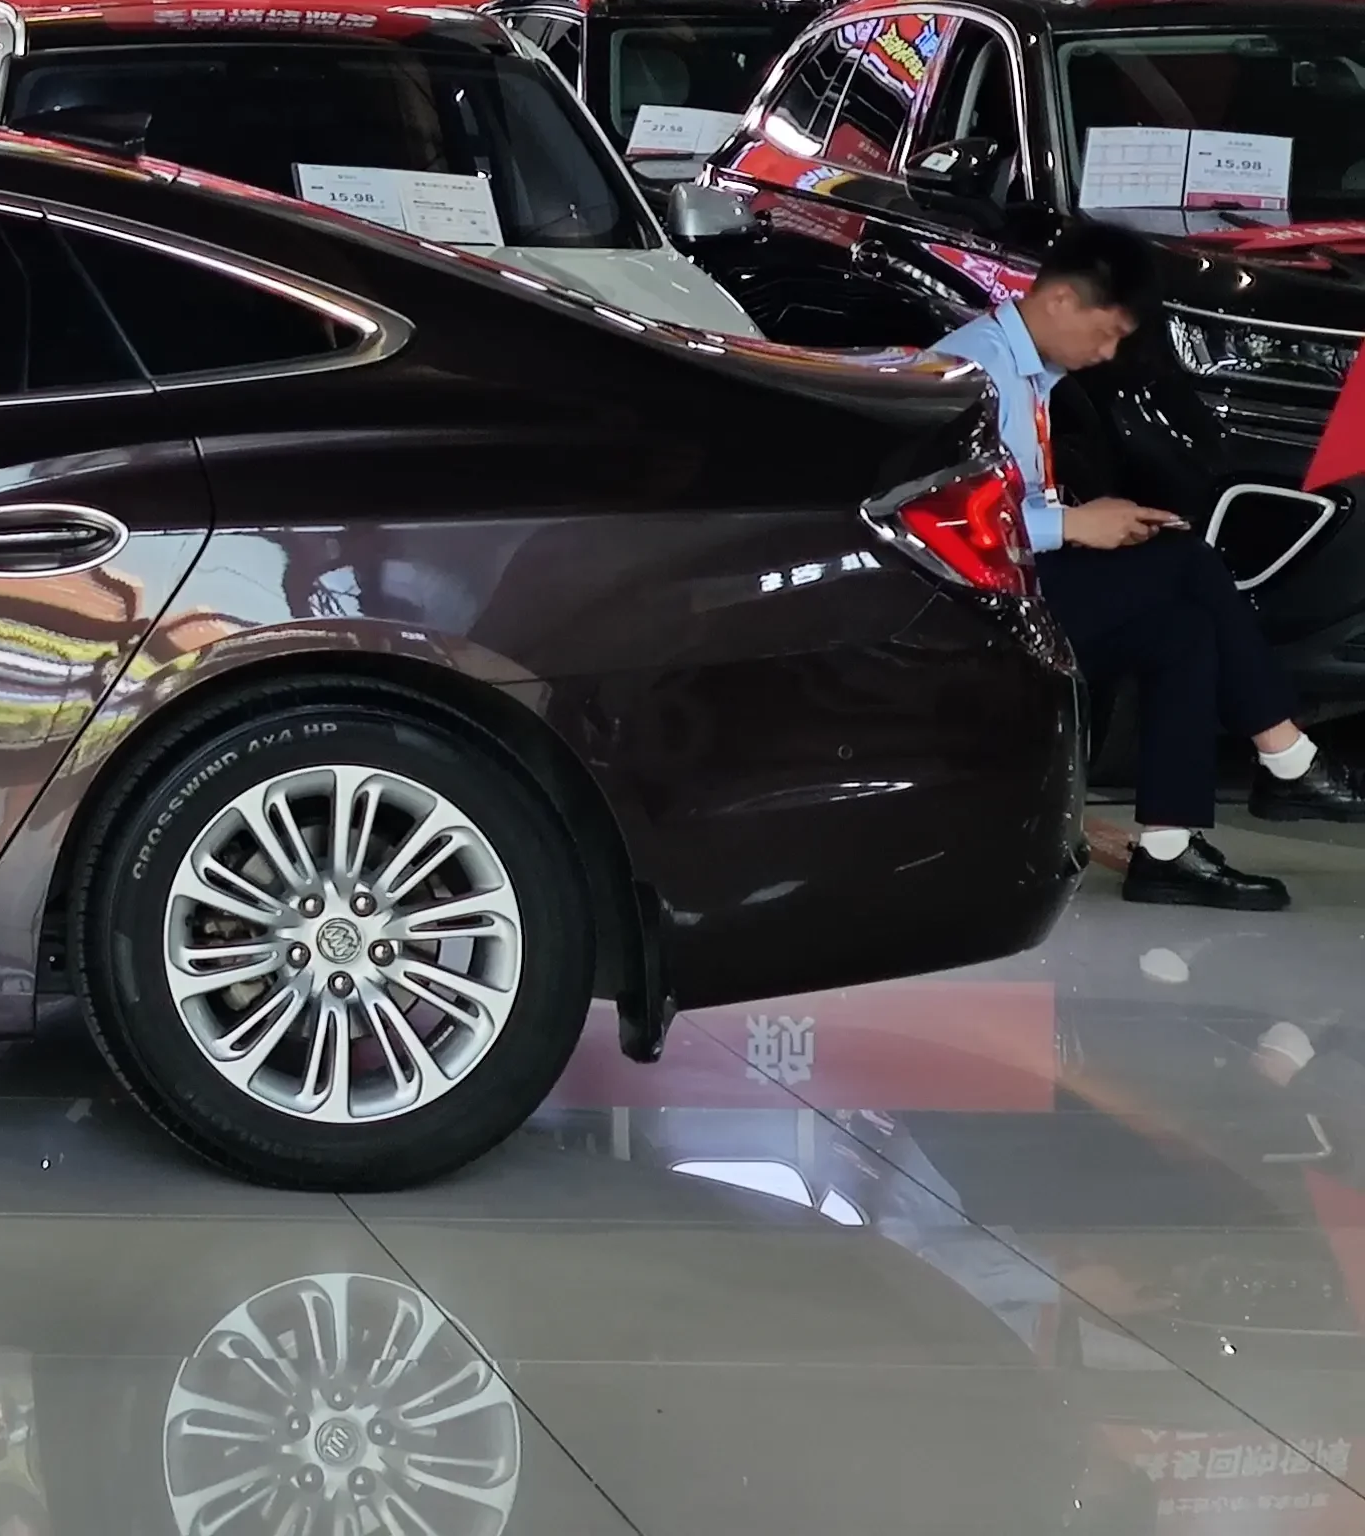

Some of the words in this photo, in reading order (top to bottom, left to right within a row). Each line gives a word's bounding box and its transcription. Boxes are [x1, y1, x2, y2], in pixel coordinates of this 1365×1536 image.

[1215, 159, 1262, 171] 15.98
[329, 192, 374, 204] 15.98
[132, 749, 239, 881] CROSSWIND
